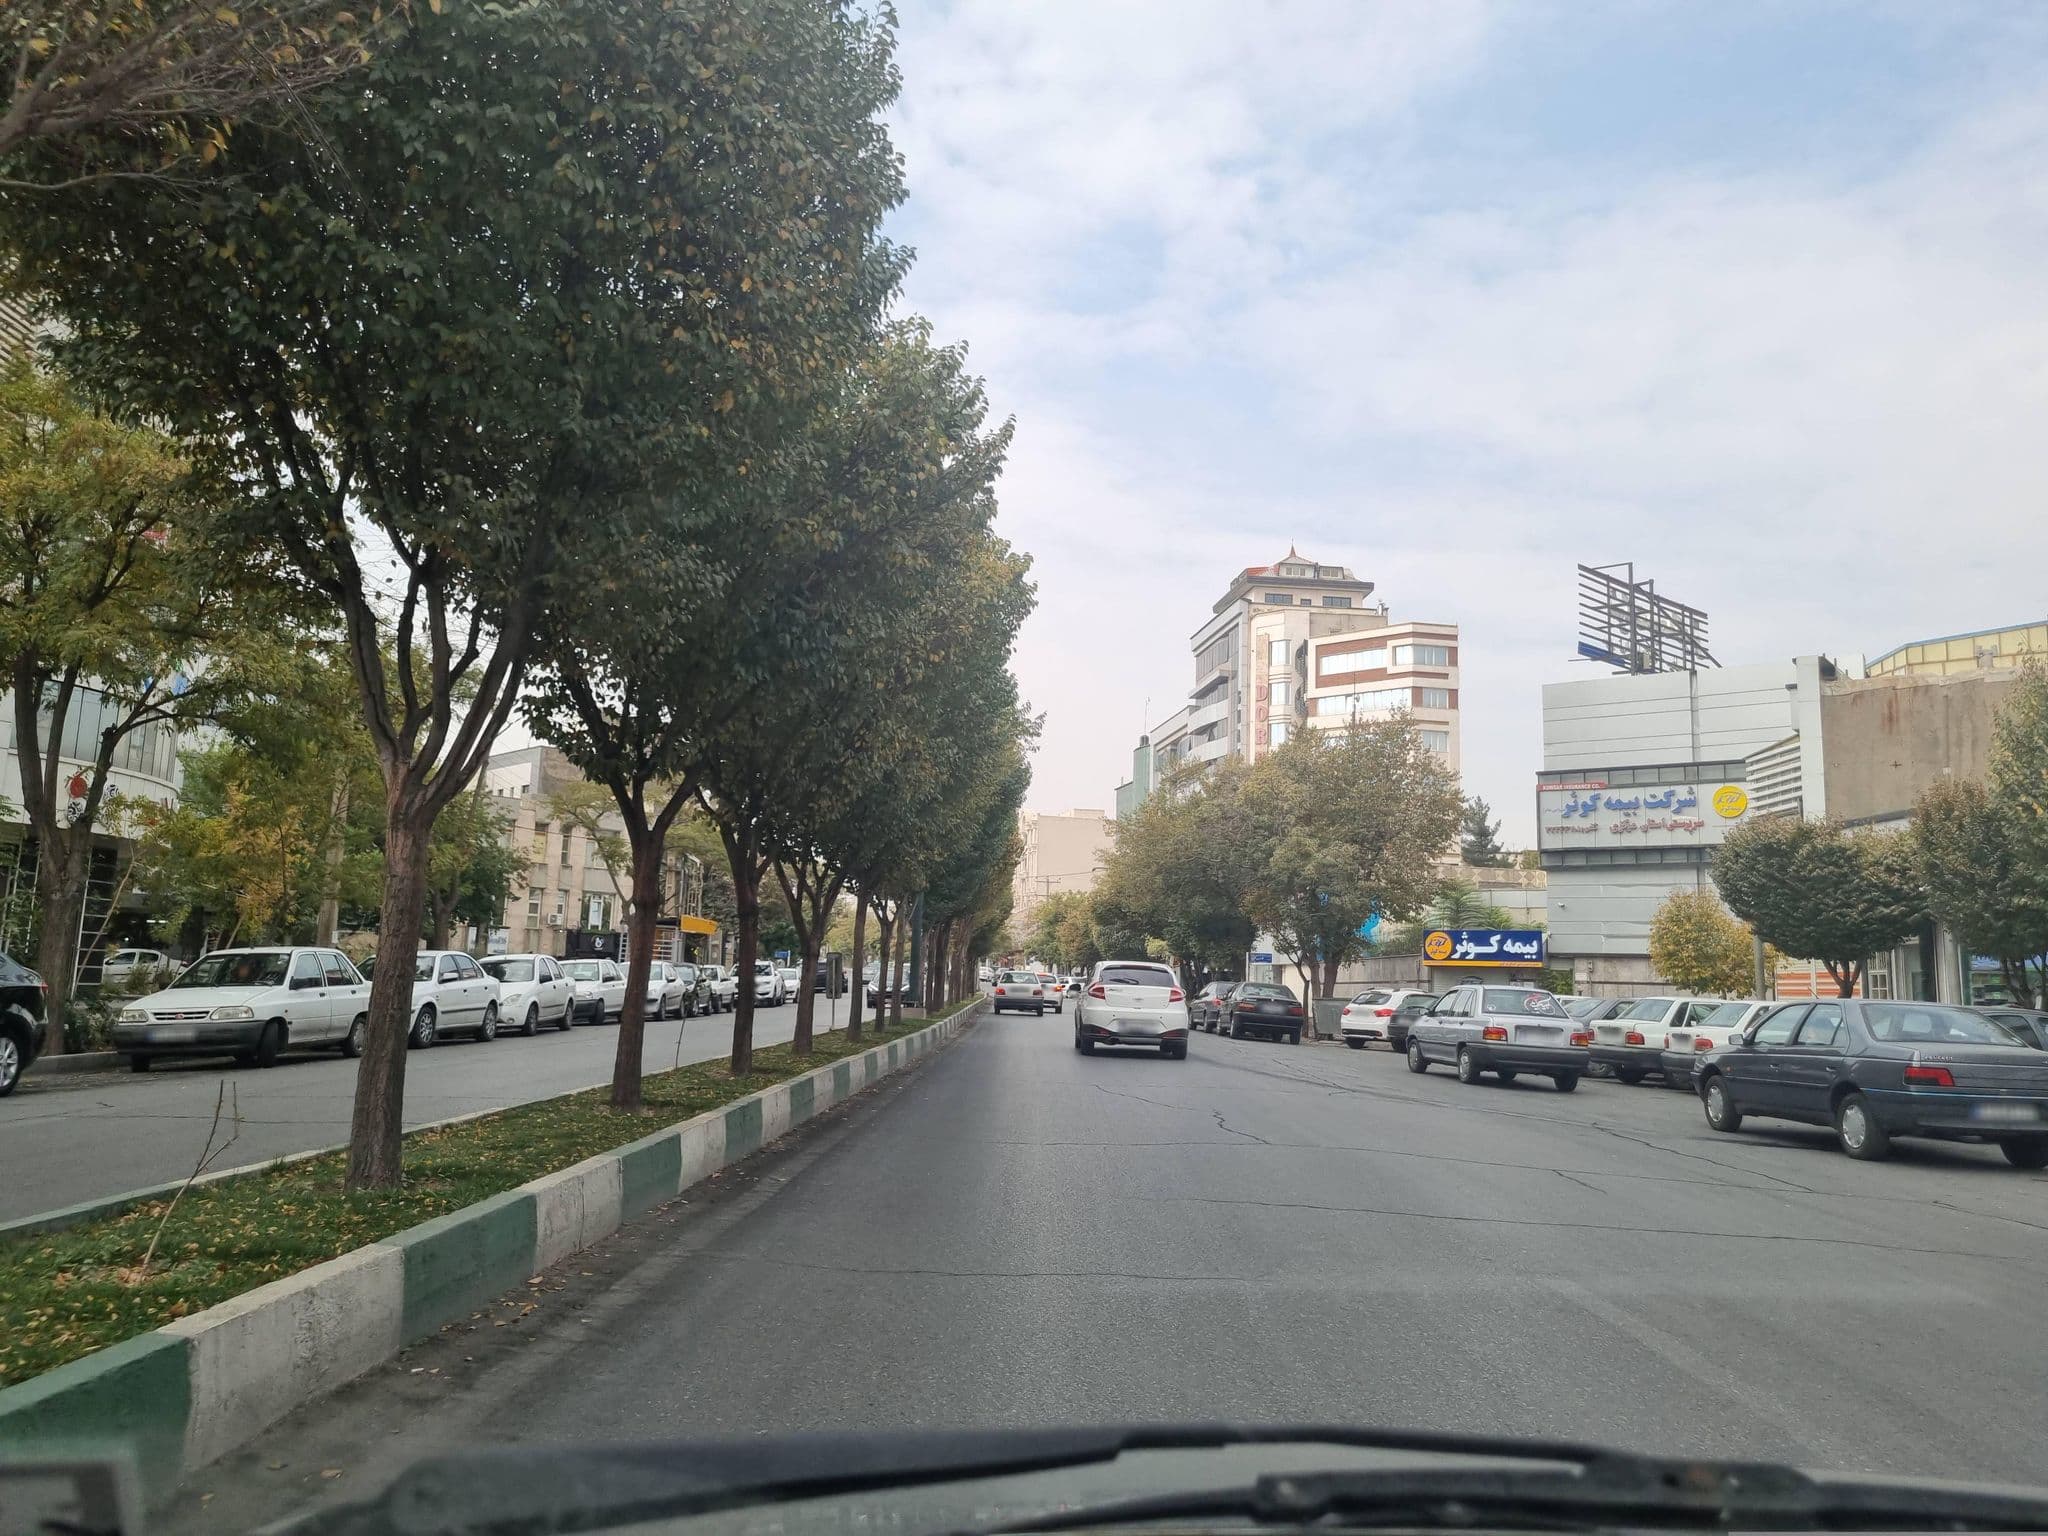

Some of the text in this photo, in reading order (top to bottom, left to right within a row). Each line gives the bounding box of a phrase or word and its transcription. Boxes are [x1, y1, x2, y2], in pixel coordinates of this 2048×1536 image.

[1561, 791, 1601, 818] کوثر
[1603, 796, 1640, 817] بیمه
[1643, 786, 1697, 815] شرکت
[1451, 931, 1538, 959] بیمه کوثر
